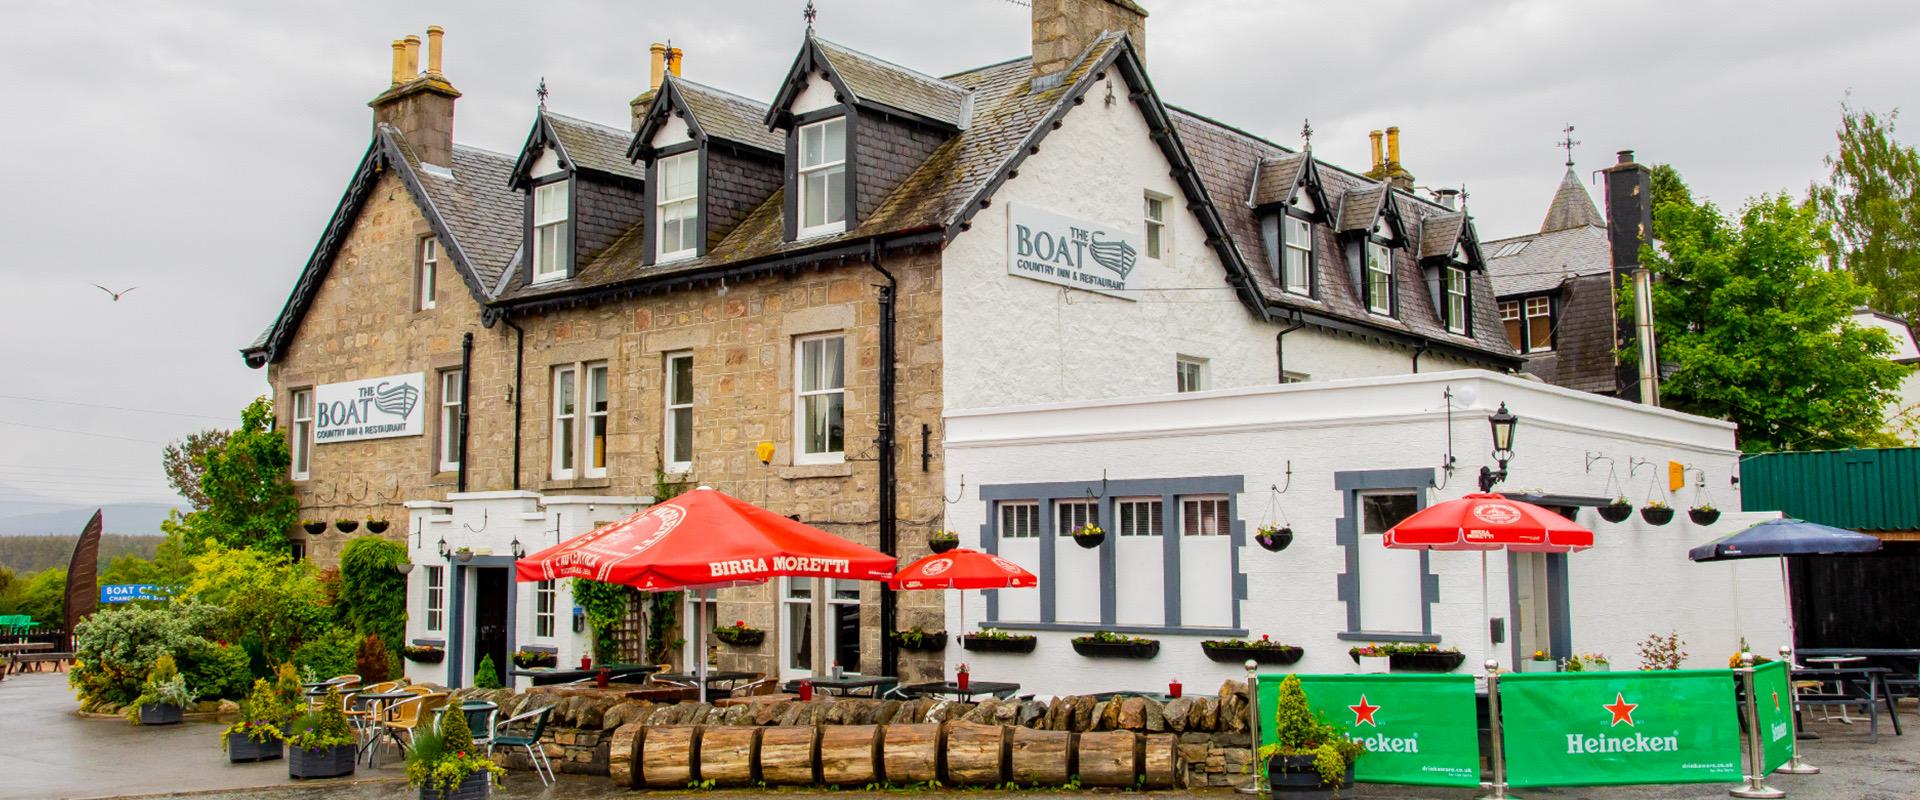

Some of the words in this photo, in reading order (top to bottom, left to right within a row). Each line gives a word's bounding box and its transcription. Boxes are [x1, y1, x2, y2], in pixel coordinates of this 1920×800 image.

[1070, 226, 1089, 241] THE
[1016, 224, 1088, 269] BOAT
[1017, 259, 1055, 275] COUNTRY
[1057, 267, 1070, 279] INN
[1072, 271, 1078, 281] &
[1080, 272, 1126, 291] RESTAURANT
[358, 386, 375, 397] THE
[317, 397, 373, 428] BOAT
[317, 429, 346, 439] COUNTRY
[347, 427, 358, 436] INN
[359, 427, 363, 436] &
[365, 422, 407, 434] RESTAURANT
[709, 557, 769, 577] BIRRA
[772, 556, 849, 574] MORETTI
[106, 586, 135, 595] BOAT
[1344, 732, 1418, 753] ineken
[1566, 732, 1679, 754] Heineken
